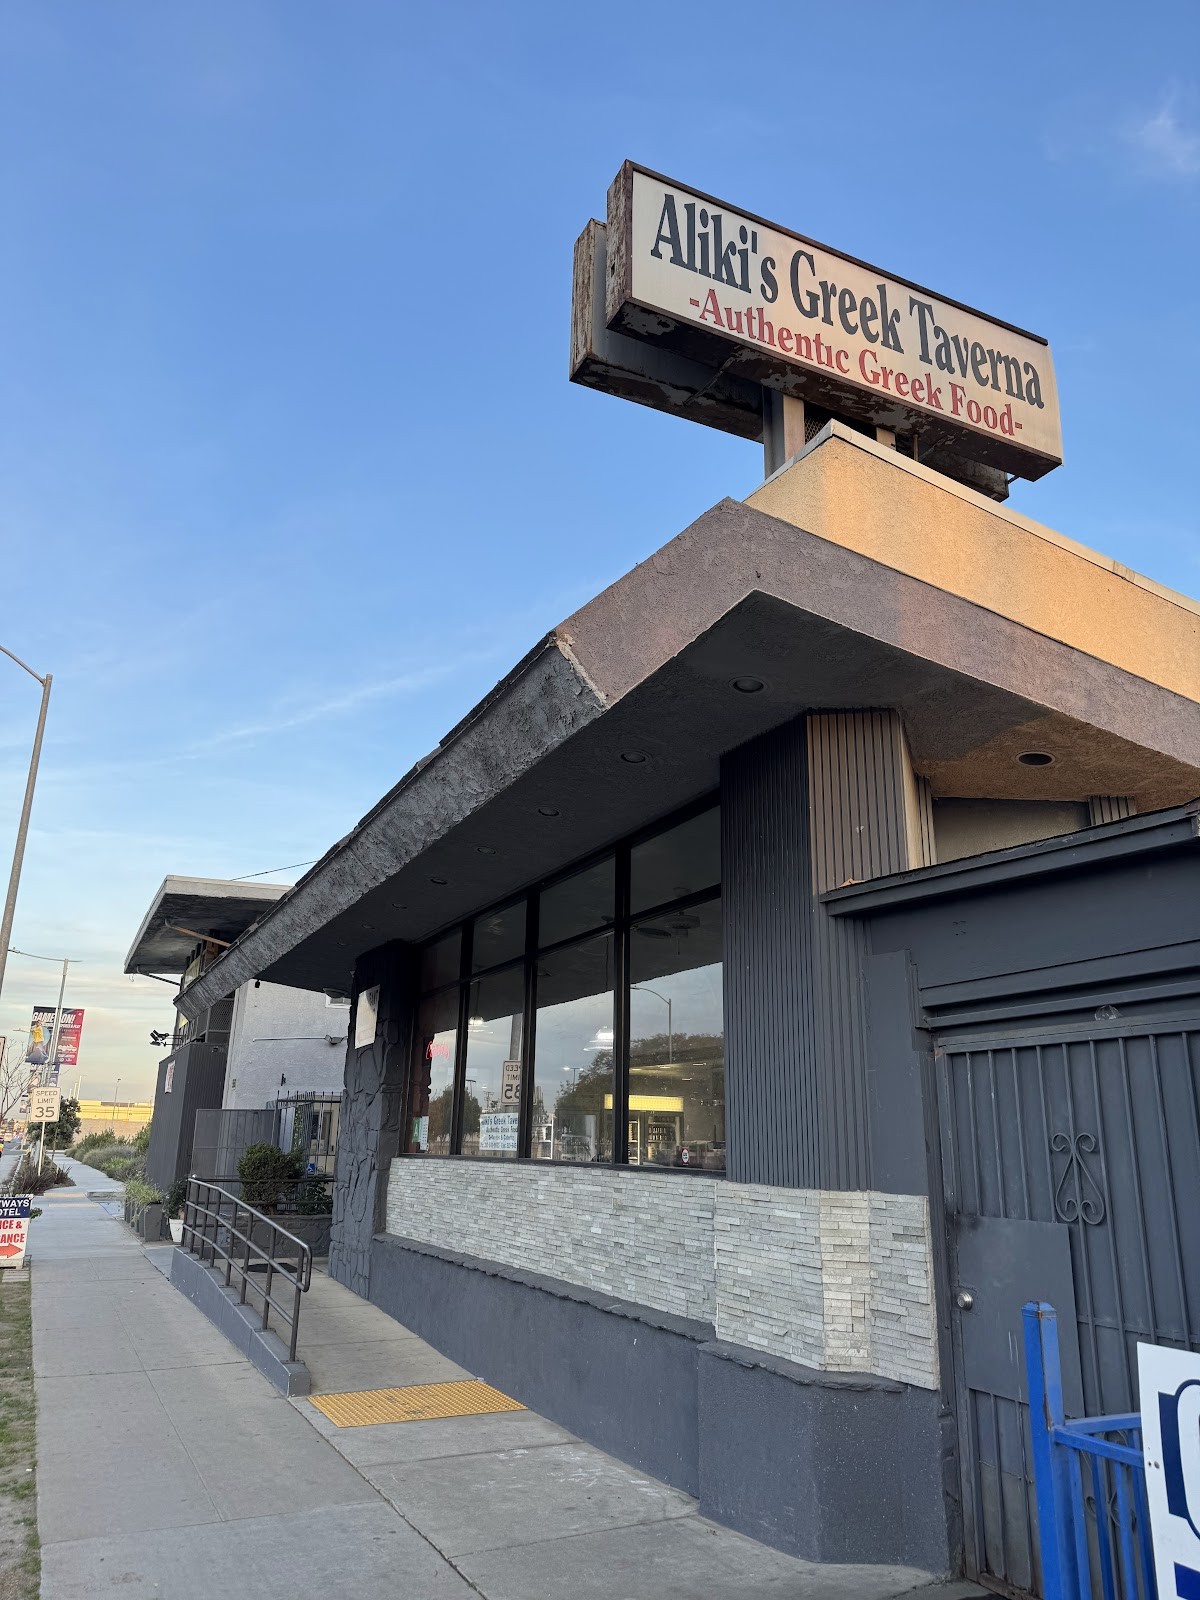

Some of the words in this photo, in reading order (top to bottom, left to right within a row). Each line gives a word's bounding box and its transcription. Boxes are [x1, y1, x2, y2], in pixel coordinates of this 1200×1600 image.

[651, 193, 778, 303] Aliki's
[790, 249, 904, 353] Greek
[909, 296, 1044, 408] Taverna
[858, 349, 943, 409] Greek
[948, 381, 1022, 435] Food-
[32, 1012, 55, 1022] GAME
[61, 1014, 76, 1023] ON!
[35, 1106, 55, 1118] 35
[0, 1199, 29, 1208] WAYS
[15, 1220, 23, 1229] &
[0, 1233, 25, 1244] ANCE
